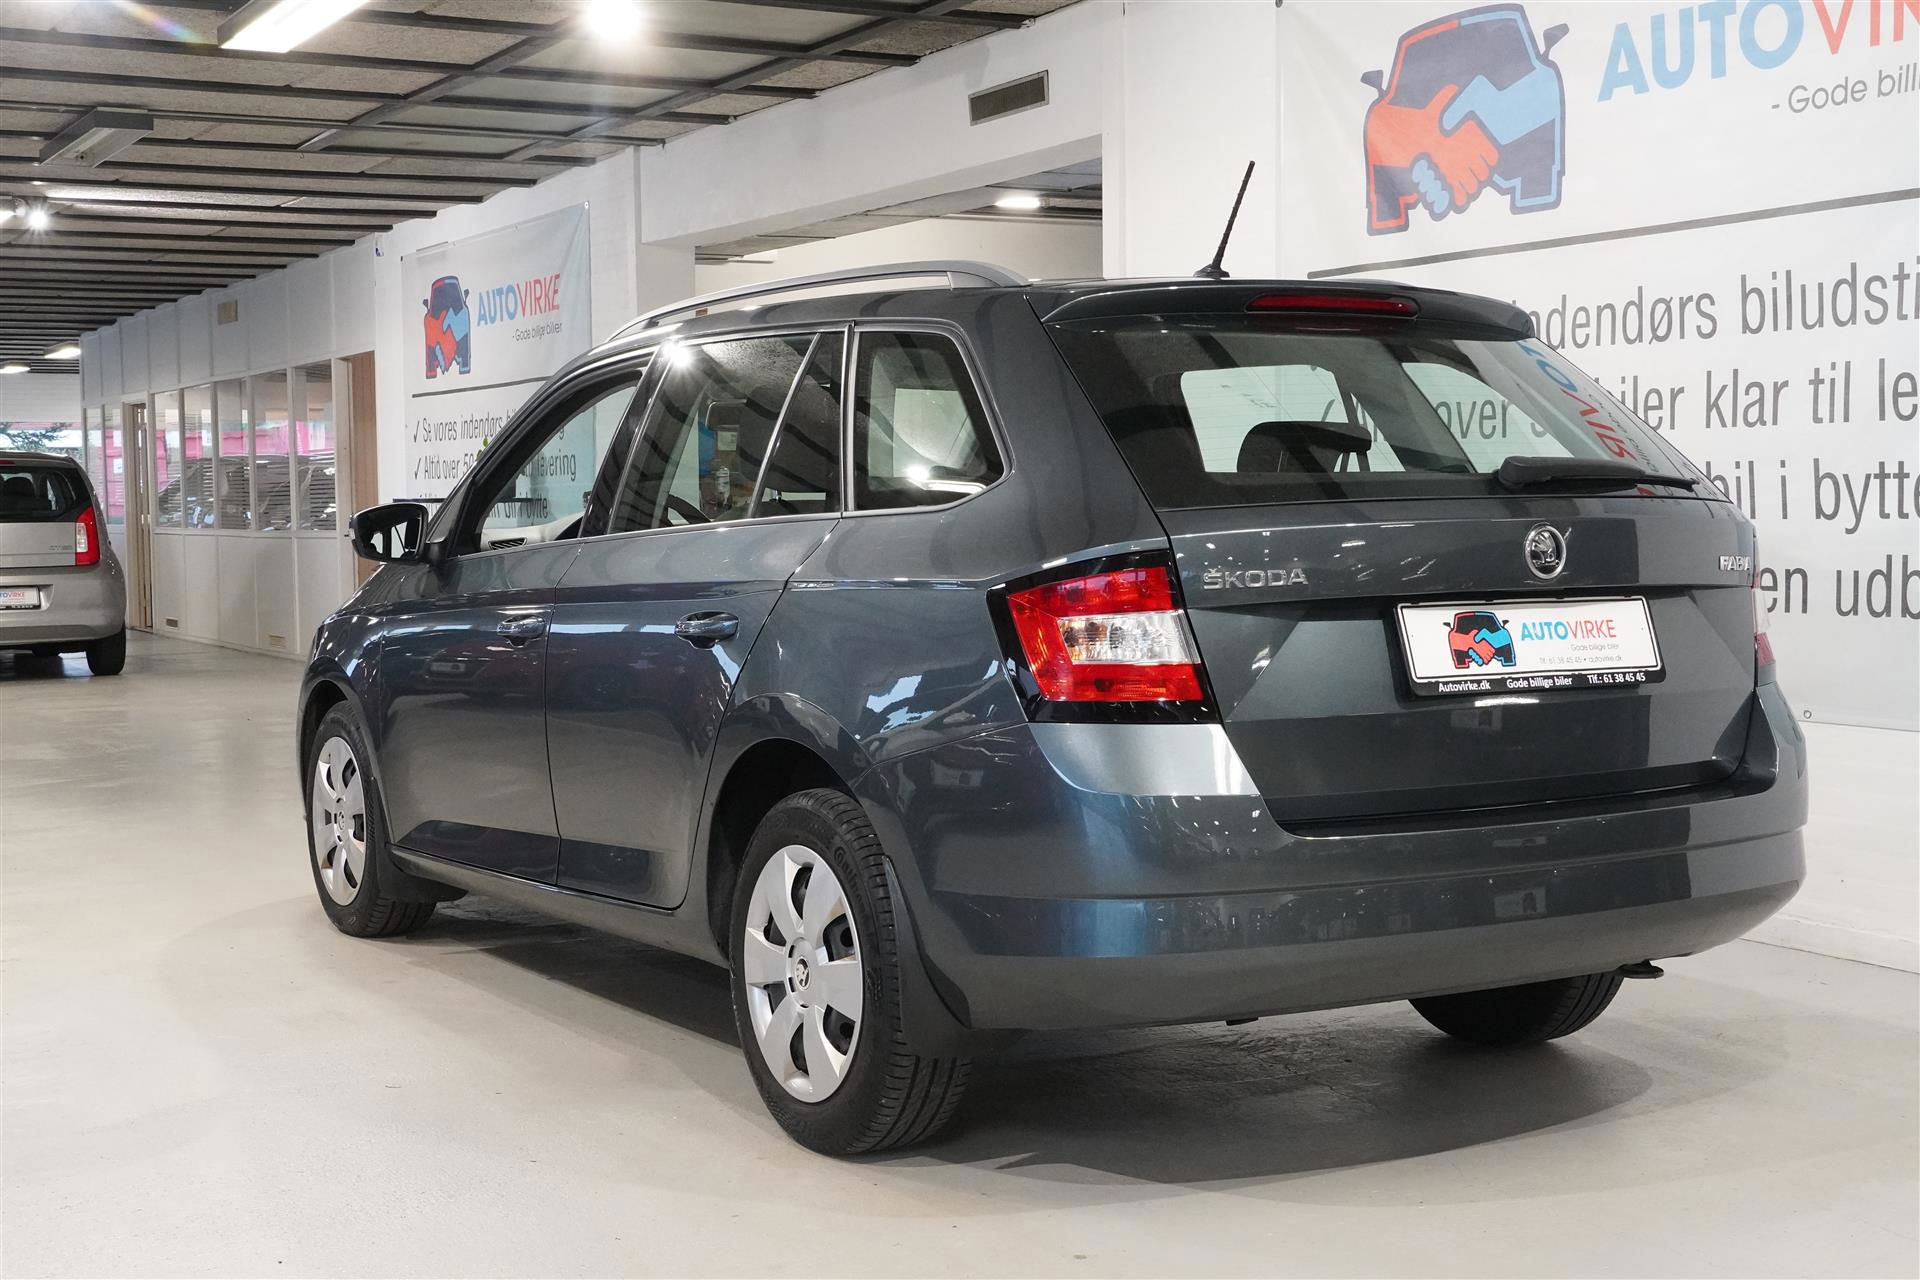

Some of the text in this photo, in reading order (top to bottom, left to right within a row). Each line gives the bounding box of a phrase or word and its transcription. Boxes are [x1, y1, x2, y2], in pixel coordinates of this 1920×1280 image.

[1788, 76, 1868, 114] Gode
[1877, 62, 1920, 98] bill
[477, 272, 561, 327] AUTOVIRKE
[1512, 285, 1718, 351] ndendørs
[1594, 375, 1685, 432] iler
[1705, 368, 1789, 429] klar
[1808, 361, 1851, 424] til
[423, 418, 432, 443] Se
[434, 421, 458, 441] vores
[461, 411, 503, 440] indendørs
[424, 455, 440, 480] Altid
[443, 459, 460, 480] over
[537, 448, 577, 482] levering
[1780, 459, 1788, 520] i
[1203, 568, 1309, 590] ŠKODA
[1521, 619, 1617, 640] AUTOVIRKE
[1438, 680, 1491, 693] Autovirke.dk
[1507, 678, 1528, 689] Gode
[1530, 676, 1553, 689] billige
[1554, 675, 1573, 687] biler
[1603, 674, 1613, 683] 61
[1614, 674, 1624, 682] 38
[1625, 673, 1635, 682] 45
[1636, 673, 1646, 682] 45
